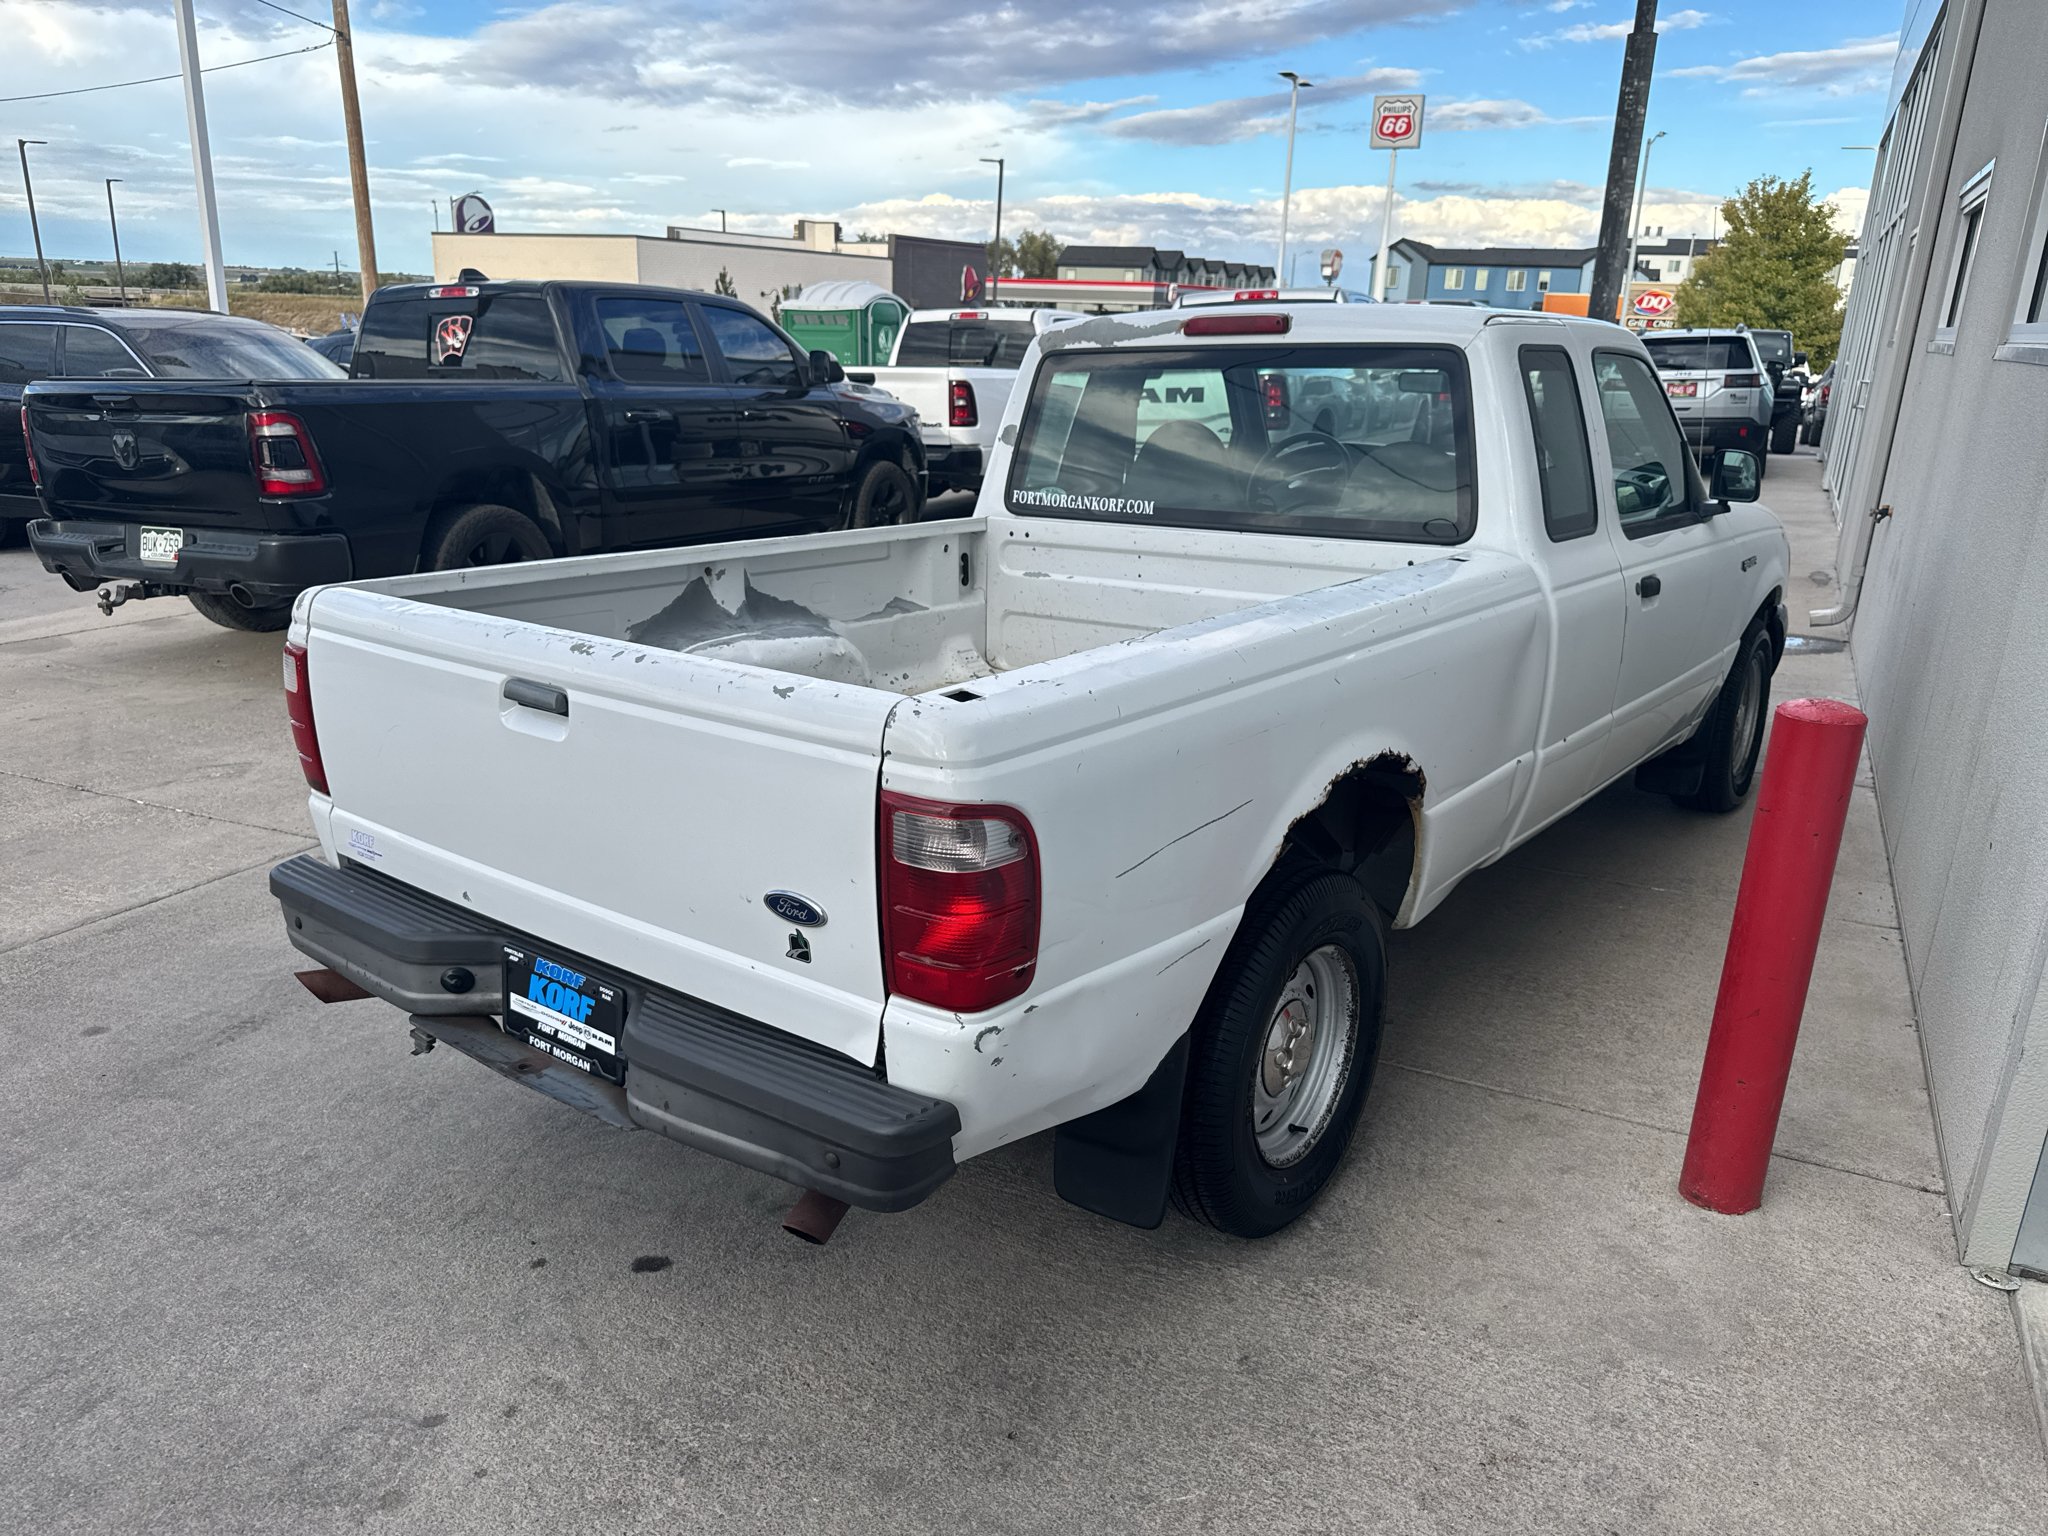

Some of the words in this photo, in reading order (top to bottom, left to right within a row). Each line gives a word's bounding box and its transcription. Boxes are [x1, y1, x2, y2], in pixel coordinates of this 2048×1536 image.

[1382, 105, 1412, 114] PHILLIPS
[1382, 117, 1409, 134] 66
[1641, 295, 1668, 310] DQ
[1140, 387, 1205, 403] AM
[1012, 489, 1155, 515] FORTMORGANKORF.COM
[351, 829, 375, 848] KORF
[777, 897, 808, 920] Ford
[535, 957, 586, 989] KORF
[528, 974, 596, 1023] KORF
[537, 1021, 556, 1036] FORT
[557, 1030, 587, 1051] MORGAN
[567, 1020, 583, 1034] Jeep
[592, 1032, 613, 1047] RAM
[529, 1035, 552, 1053] FORT
[553, 1045, 591, 1072] MORGAN
